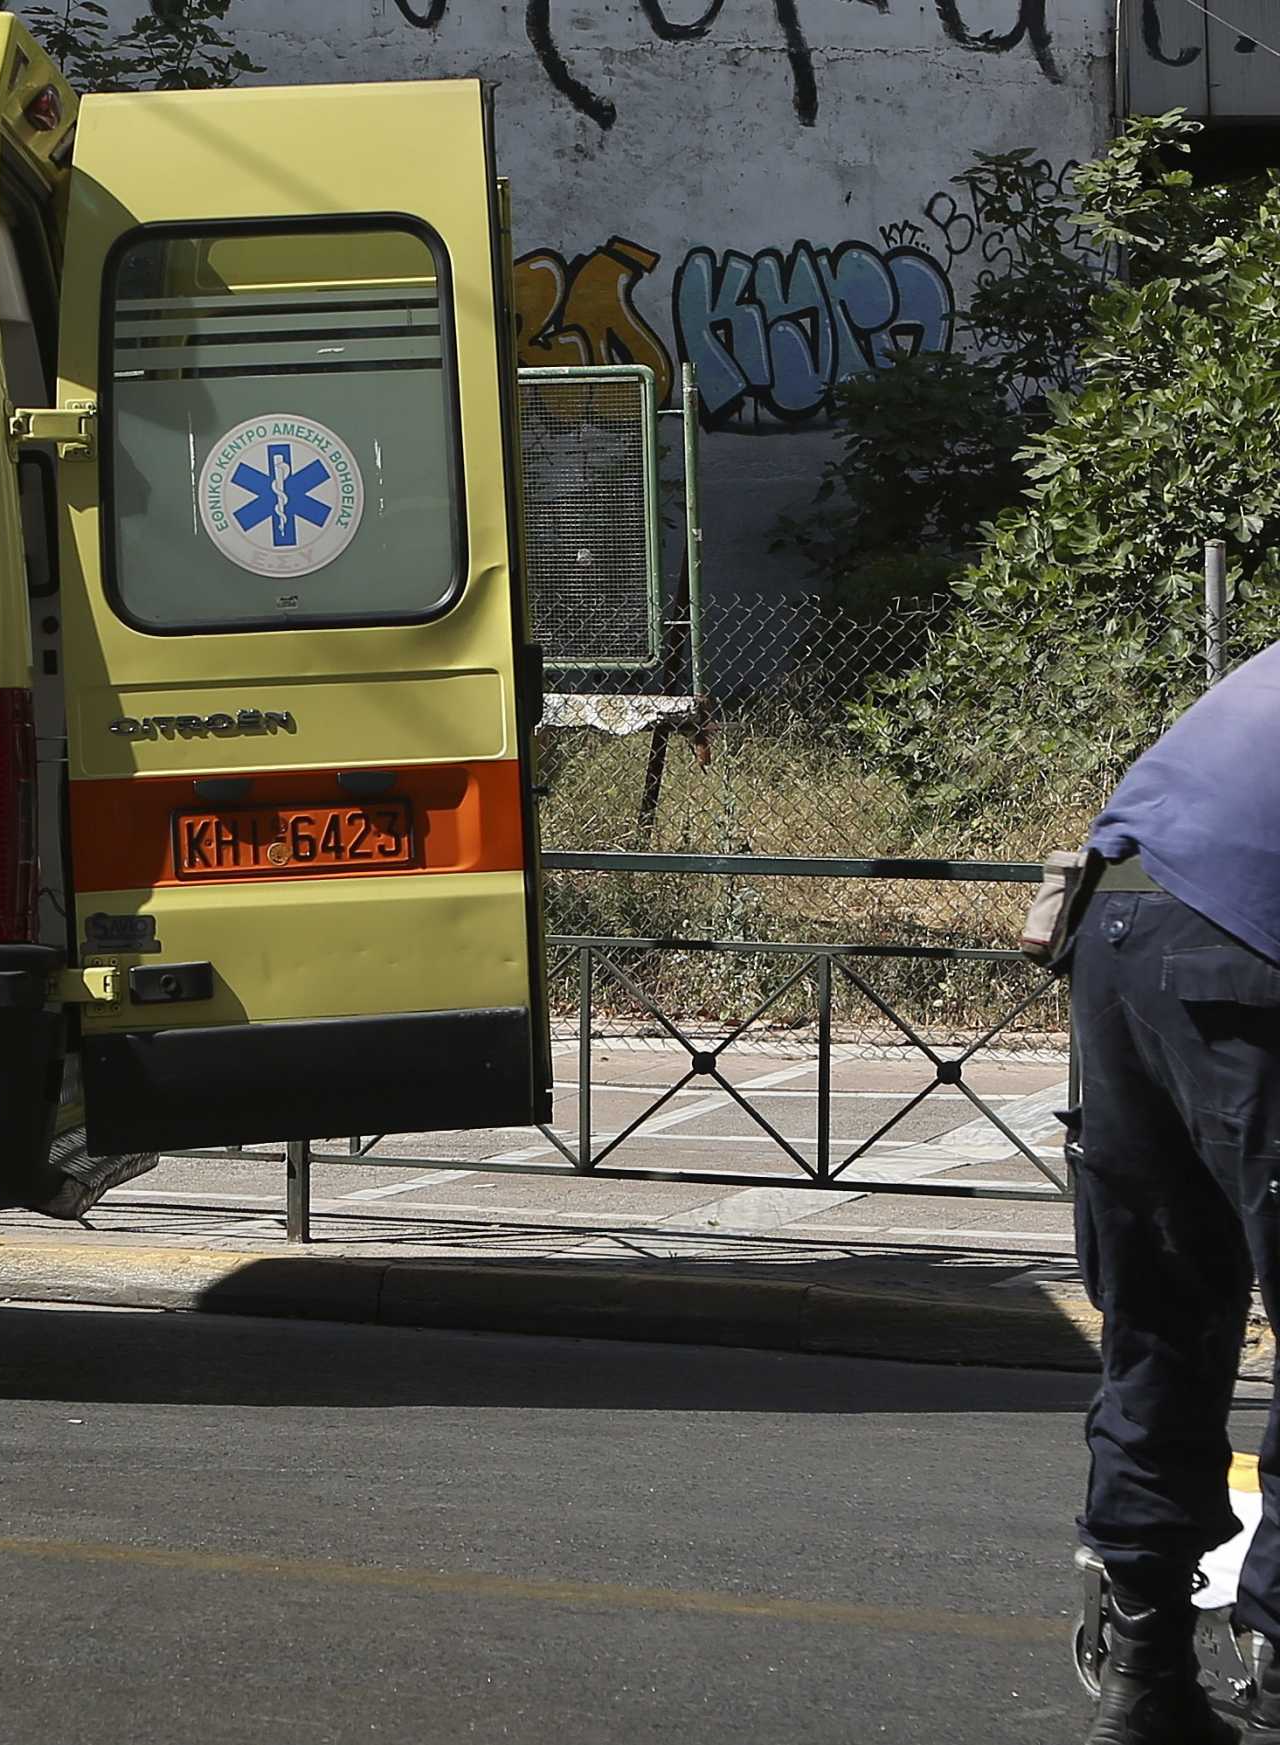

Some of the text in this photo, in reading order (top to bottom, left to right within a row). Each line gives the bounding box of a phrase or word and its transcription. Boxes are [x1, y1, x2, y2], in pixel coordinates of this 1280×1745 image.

[208, 423, 355, 533] ΕΘΝΙΚΟ ΚΕΝΤΡΟ ΑΜΕΣΗΣ ΒΟΗΘΕΙΑΣ
